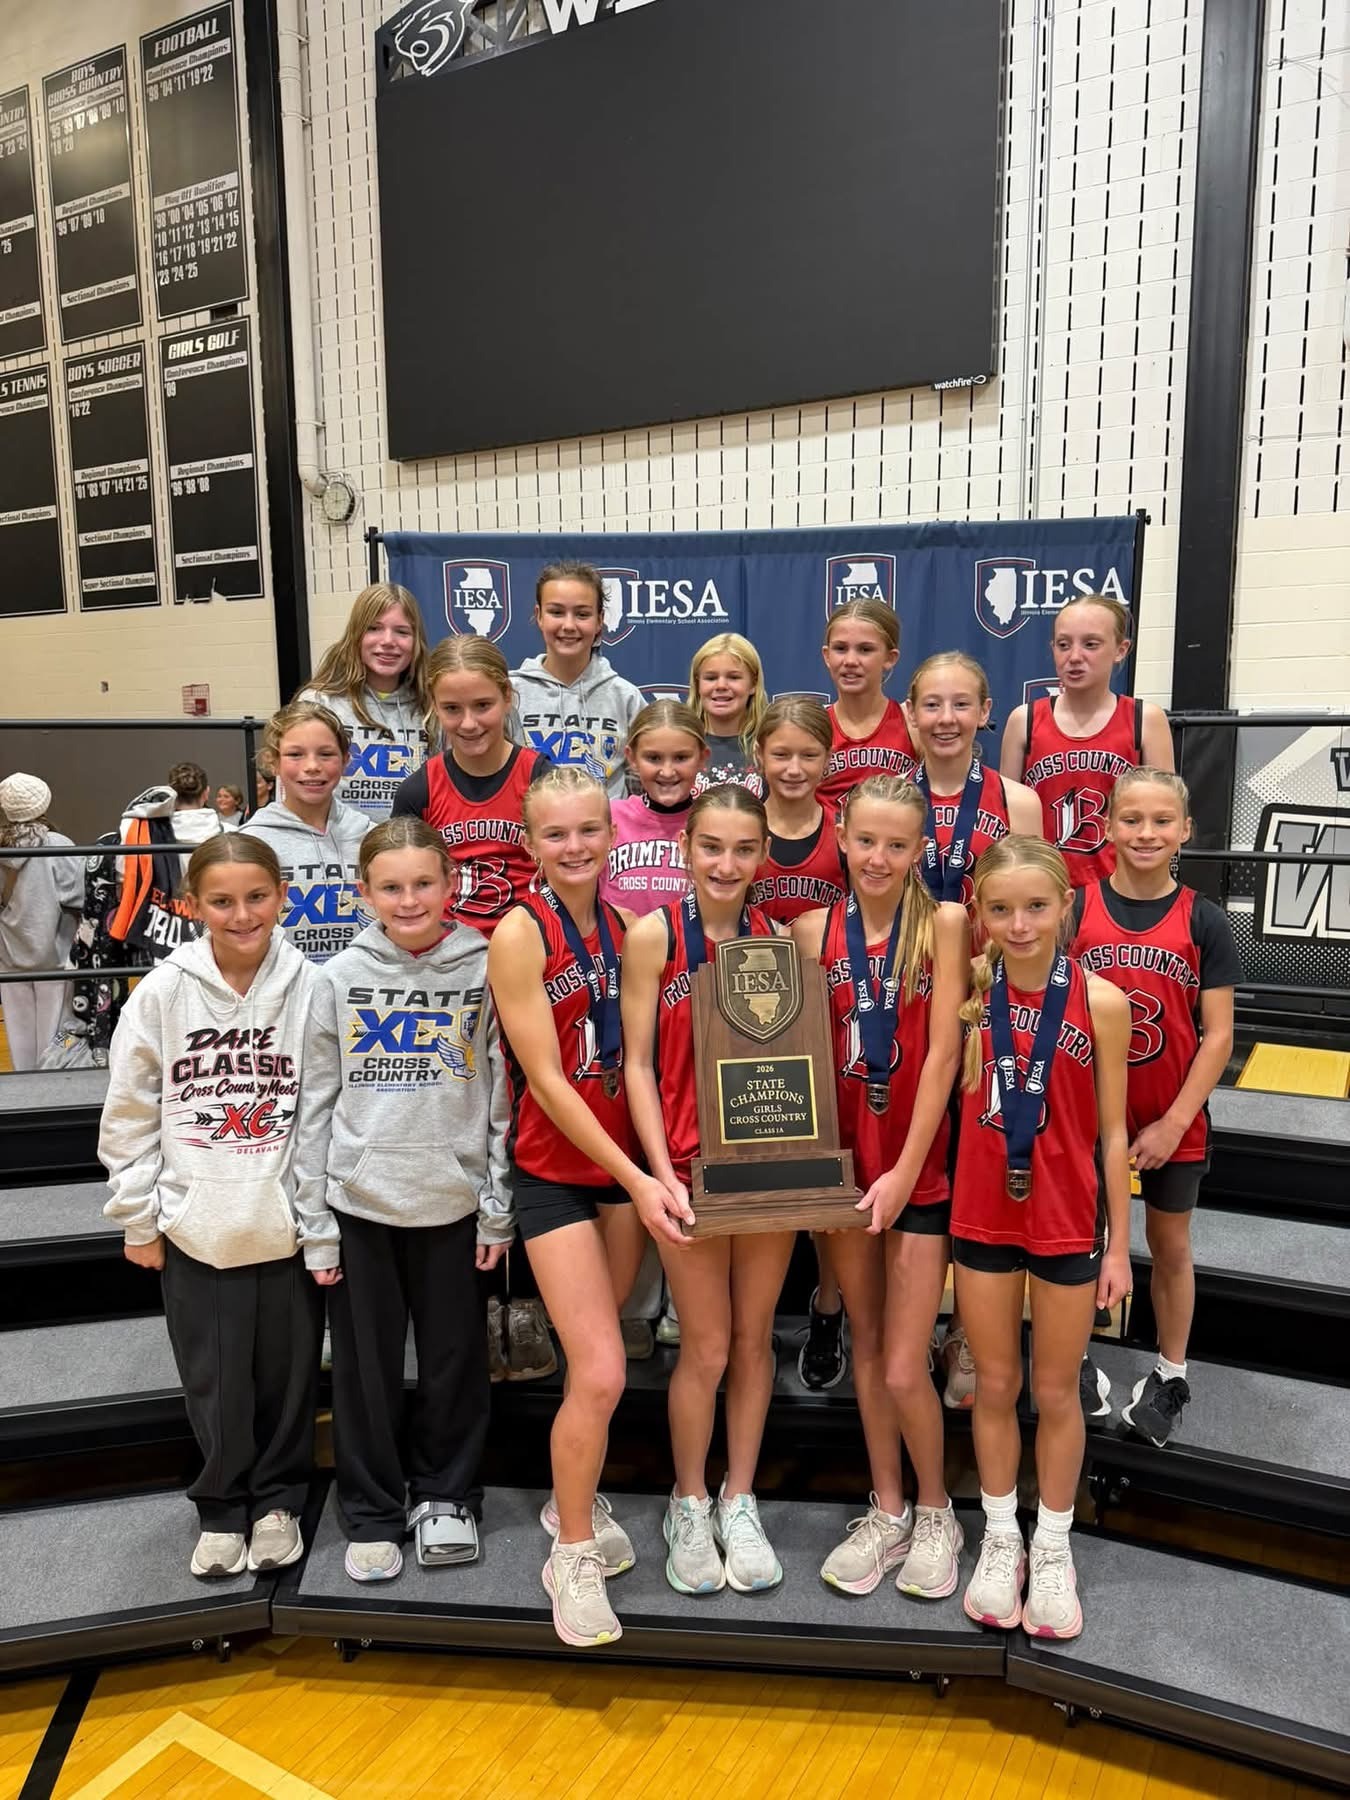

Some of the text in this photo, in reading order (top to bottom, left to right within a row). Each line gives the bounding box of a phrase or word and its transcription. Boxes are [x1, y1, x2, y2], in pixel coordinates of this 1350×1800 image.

[154, 18, 219, 58] FOOTBALL
[188, 43, 228, 65] Champions
[71, 63, 96, 83] BOYS
[160, 78, 173, 97] '04
[173, 73, 186, 92] '11
[187, 68, 200, 86] '19
[200, 63, 214, 83] '22
[48, 65, 122, 107] CROSS COUNTRY
[112, 96, 125, 114] '10
[93, 207, 105, 224] '10
[181, 203, 194, 221] '04
[195, 199, 209, 217] '05
[224, 190, 238, 208] '07
[154, 210, 239, 248] '10 '11 '12 '13 '14 '15
[156, 231, 238, 266] '16 '17 '18 '19 '21 '22
[157, 261, 198, 286] '23 '24 '25
[168, 328, 240, 360] GIRLS GOLF
[68, 351, 141, 382] BOYS SOCCER
[11, 372, 47, 395] TENNIS
[934, 377, 973, 390] watchfire
[206, 458, 244, 472] Champions
[111, 478, 123, 494] '14
[123, 477, 134, 492] '21
[136, 475, 148, 491] '25
[84, 532, 112, 543] Sectional
[181, 548, 250, 565] Sectional Champions
[453, 588, 503, 609] IESA
[626, 579, 728, 618] IESA
[1020, 567, 1130, 609] IESA
[523, 714, 618, 732] STATE
[528, 730, 595, 764] XC
[343, 742, 414, 779] XC
[466, 819, 527, 845] COUNT
[280, 863, 361, 882] STAT
[618, 876, 648, 891] CROSS
[280, 883, 364, 928] XC
[294, 927, 354, 941] CROSS
[544, 961, 587, 1007] ROSS
[662, 969, 692, 1008] CRO
[731, 971, 790, 994] IESA
[347, 987, 485, 1007] STATE
[184, 1026, 277, 1052] DARE
[349, 1008, 454, 1054] XC
[170, 1052, 297, 1087] CLASSIC
[363, 1057, 432, 1070] CROSS
[756, 1064, 774, 1073] 2026
[349, 1069, 443, 1083] COUNTRY
[746, 1079, 785, 1090] STATE
[180, 1083, 215, 1102] Cross
[266, 1078, 299, 1096] Meet
[730, 1090, 805, 1108] CHAMPIONS
[210, 1098, 278, 1140] XC
[730, 1112, 807, 1125] CROSS COUNTRY
[753, 1104, 783, 1114] GIRLS
[236, 1146, 280, 1155] DELAVAN
